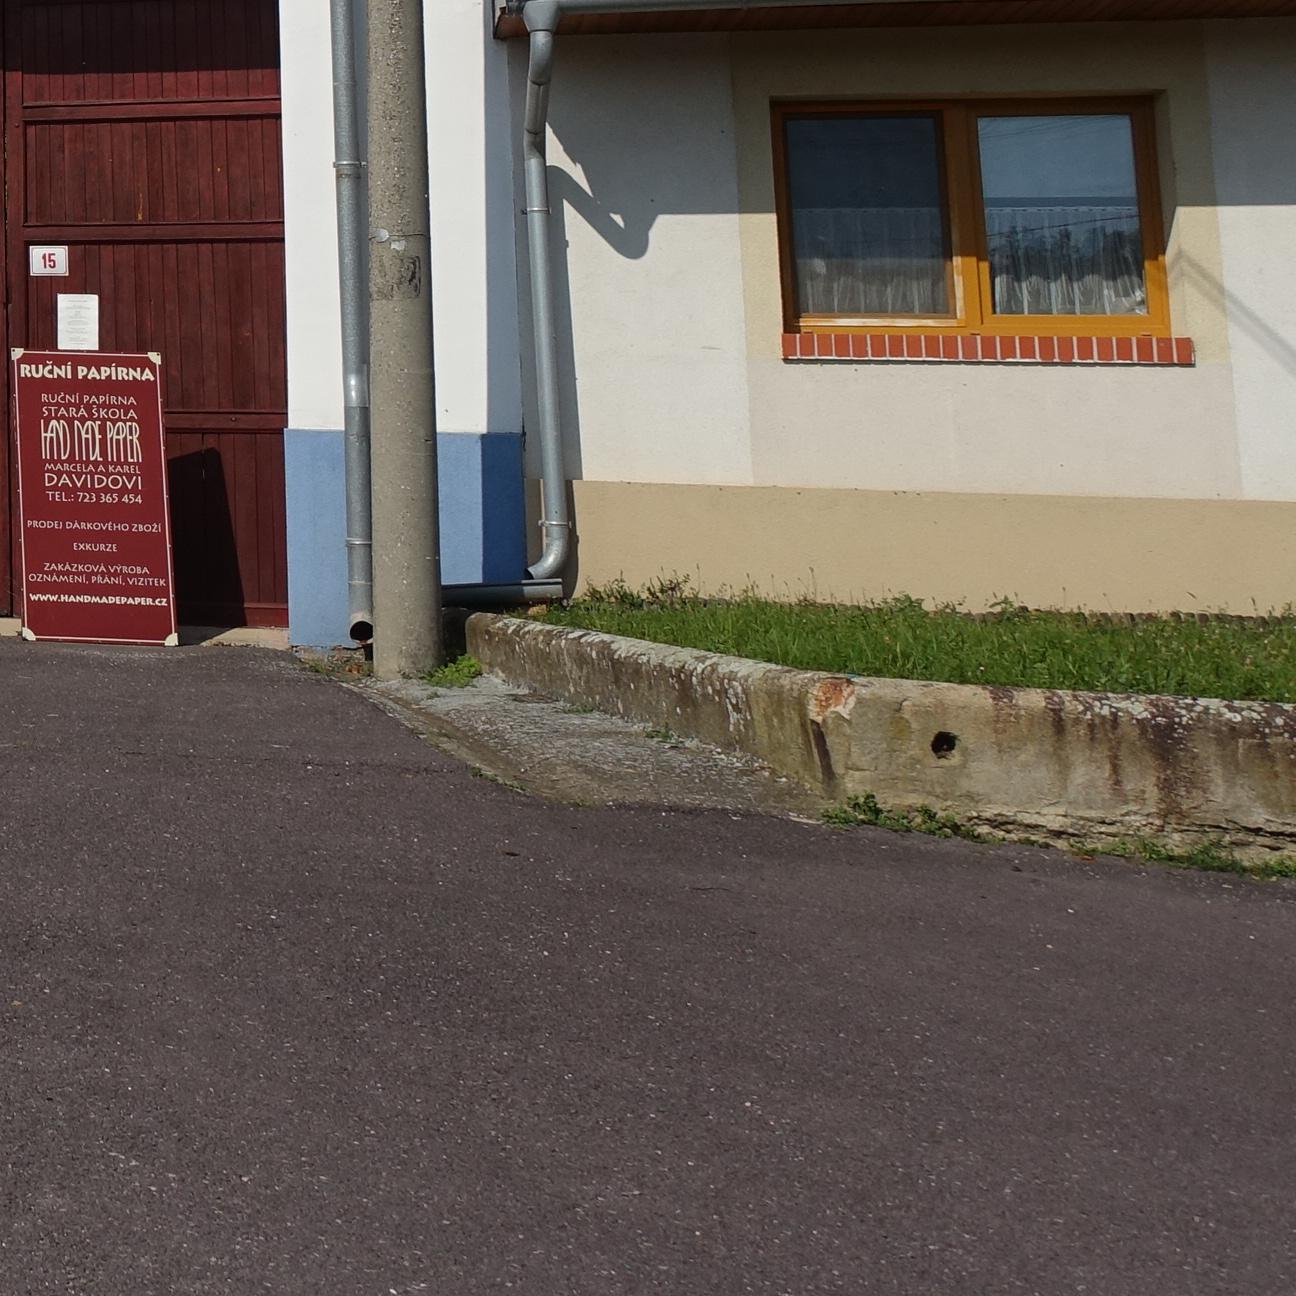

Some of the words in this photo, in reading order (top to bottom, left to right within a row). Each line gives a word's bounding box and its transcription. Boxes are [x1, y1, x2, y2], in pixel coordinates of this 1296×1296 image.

[42, 253, 56, 268] 15
[20, 361, 72, 379] RUČNÍ
[77, 363, 155, 381] PAPÍRNA
[41, 392, 79, 404] RUČNÍ
[83, 393, 137, 405] PAPÍRNA
[42, 405, 88, 418] STARÁ
[92, 406, 138, 420] ŠKOLA
[40, 419, 70, 460] HAND
[106, 421, 142, 463] PAPER
[44, 463, 96, 472] MARCELA
[98, 464, 106, 473] A
[108, 465, 141, 474] KAREL
[44, 473, 142, 490] DAVIDOVI
[46, 491, 74, 502] TEL.:
[77, 492, 96, 503] 723
[100, 493, 118, 504] 365
[122, 494, 142, 504] 454
[28, 520, 62, 529] PRODEJ
[66, 520, 129, 531] DÁRKOVÉHO
[132, 522, 162, 532] ZBOŽÍ
[73, 542, 118, 552] EXKURZE
[44, 562, 106, 573] ZAKÁZKOVÁ
[108, 564, 150, 574] VÝROBA
[28, 572, 88, 584] OZNÁMENÍ,
[92, 574, 126, 586] PŘÁNÍ,
[127, 577, 166, 586] VIZITEK
[29, 593, 168, 606] WWW.HANDMADEPAPER.CZ
